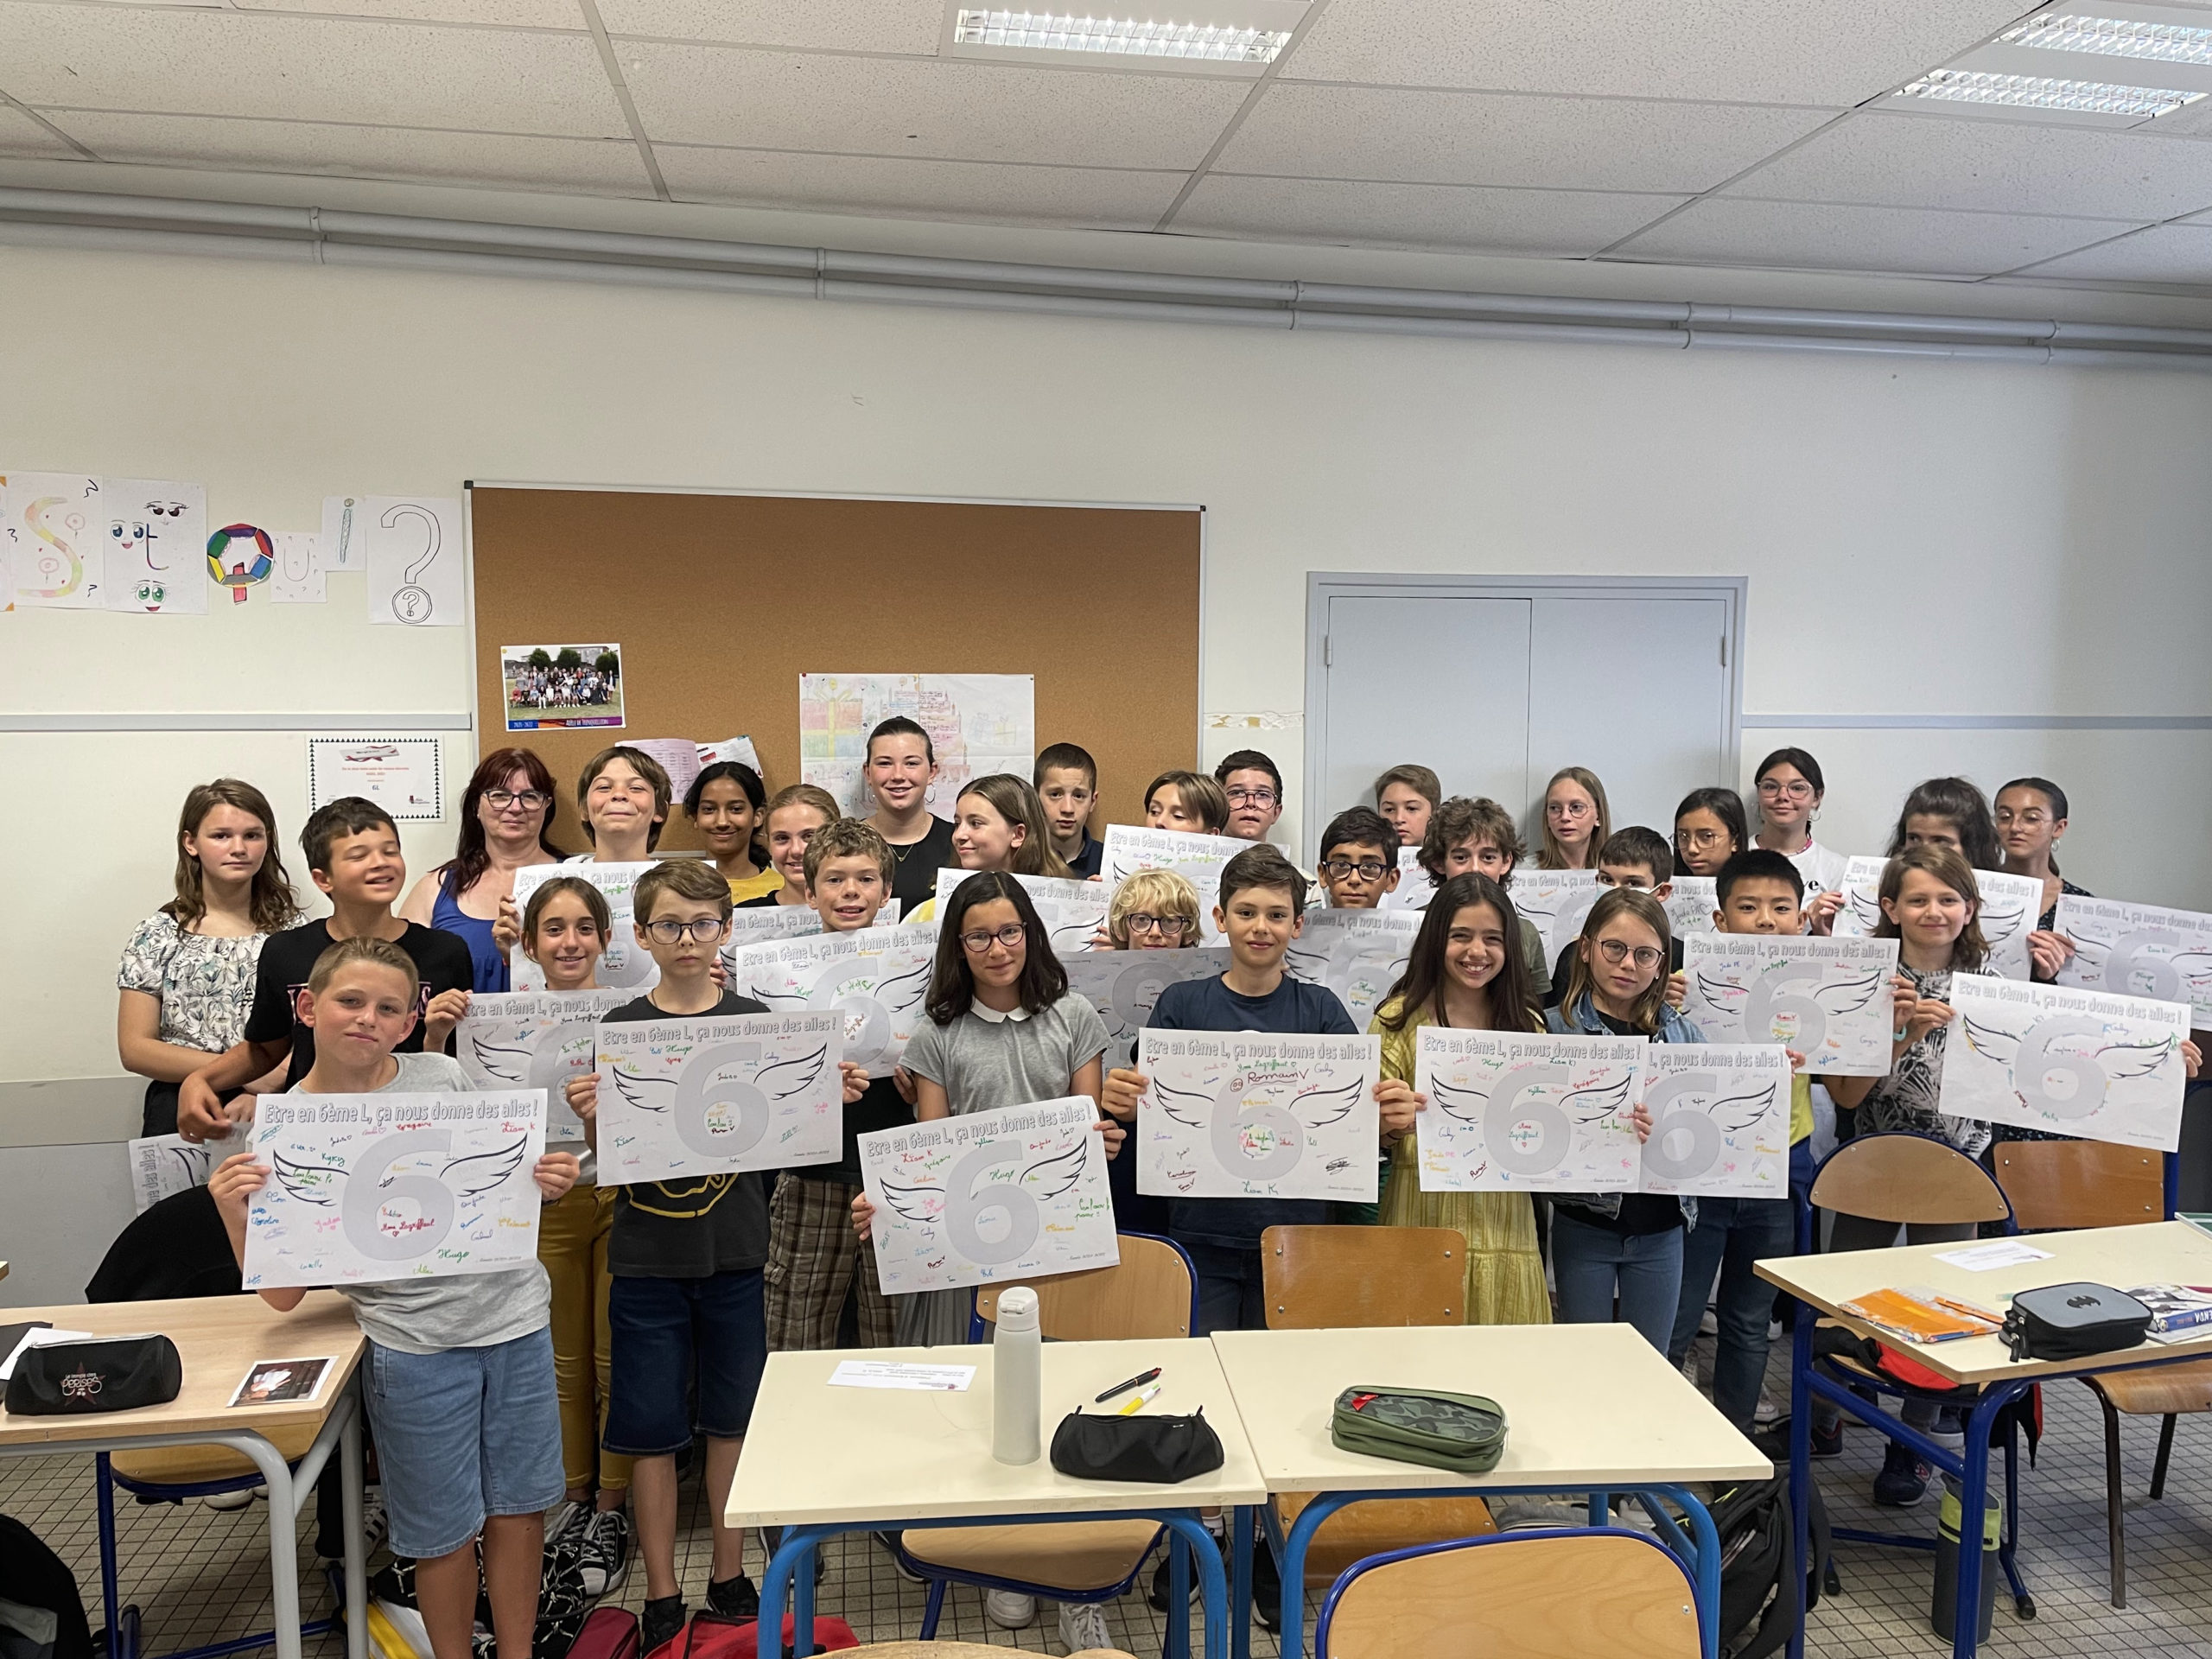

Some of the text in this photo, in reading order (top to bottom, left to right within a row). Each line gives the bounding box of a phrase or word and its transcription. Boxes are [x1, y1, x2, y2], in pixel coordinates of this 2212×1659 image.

[734, 918, 746, 929] en
[748, 912, 775, 929] 6ème
[787, 913, 798, 931] ça
[799, 912, 822, 925] nous
[743, 951, 763, 966] Etre
[765, 950, 778, 963] en
[779, 945, 808, 961] 6ème
[821, 944, 831, 961] ça
[833, 941, 857, 955] nous
[859, 935, 890, 952] donne
[892, 931, 909, 948] des
[911, 929, 932, 945] ailes
[1690, 938, 1711, 953] Etre
[1713, 942, 1726, 955] en
[1729, 939, 1756, 956] 6ème
[1768, 945, 1779, 959] ça
[1782, 944, 1807, 957] nous
[1809, 942, 1840, 957] donne
[1841, 944, 1859, 958] des
[1861, 943, 1885, 959] ailes
[489, 1001, 502, 1015] en
[505, 998, 535, 1015] 6ème
[550, 1001, 562, 1018] ça
[563, 998, 590, 1013] nous
[1959, 980, 1981, 996] Etre
[1983, 985, 1997, 998] en
[1999, 984, 2030, 1003] 6ème
[2044, 993, 2056, 1010] ça
[2058, 995, 2086, 1012] nous
[2088, 997, 2124, 1016] donne
[2126, 1001, 2147, 1019] des
[2149, 1005, 2176, 1023] ailes
[604, 1029, 627, 1046] Etre
[630, 1032, 645, 1044] en
[649, 1027, 681, 1044] 6ème
[697, 1026, 709, 1043] ça
[713, 1023, 741, 1038] nous
[744, 1020, 779, 1035] donne
[782, 1018, 801, 1033] des
[804, 1016, 830, 1032] ailes
[1146, 1038, 1168, 1054] Etre
[1171, 1042, 1185, 1055] en
[1187, 1039, 1218, 1056] 6ème
[1233, 1044, 1246, 1061] ça
[1249, 1044, 1277, 1058] nous
[1280, 1042, 1315, 1059] donne
[1318, 1043, 1337, 1059] des
[1339, 1043, 1366, 1060] ailes
[1424, 1035, 1446, 1052] Etre
[1449, 1039, 1462, 1053] en
[1465, 1037, 1495, 1055] 6ème
[1509, 1043, 1521, 1059] ça
[1523, 1044, 1551, 1058] nous
[1554, 1042, 1586, 1059] donne
[1589, 1043, 1608, 1060] des
[1610, 1043, 1635, 1060] ailes
[1661, 1053, 1672, 1070] ça
[1674, 1053, 1699, 1066] nous
[1700, 1051, 1733, 1066] donne
[1735, 1052, 1753, 1067] des
[1755, 1052, 1778, 1068] ailes
[265, 1104, 295, 1123] Etre
[297, 1107, 315, 1122] en
[319, 1103, 358, 1122] 6ème
[376, 1106, 391, 1126] ça
[395, 1105, 429, 1121] nous
[431, 1101, 474, 1121] donne
[476, 1100, 499, 1119] des
[502, 1099, 531, 1118] ailes
[867, 1140, 890, 1158] Etre
[893, 1138, 907, 1153] en
[910, 1130, 941, 1149] 6ème
[955, 1128, 969, 1146] ça
[969, 1122, 999, 1140] nous
[1001, 1116, 1036, 1135] donne
[1038, 1111, 1058, 1128] des
[1059, 1107, 1086, 1125] ailes
